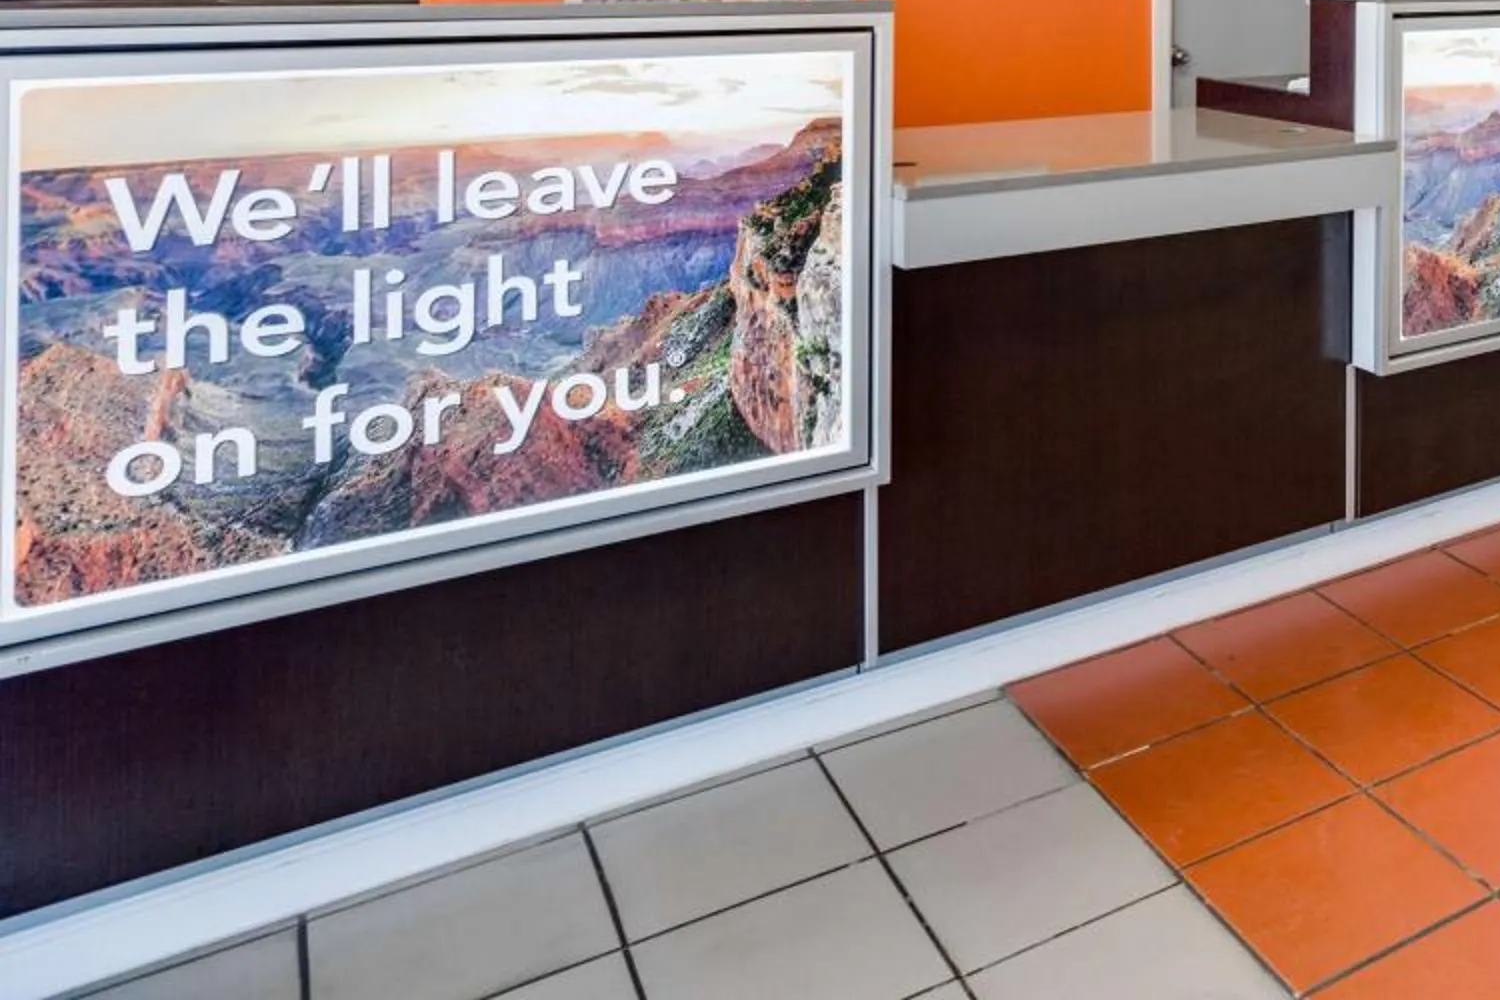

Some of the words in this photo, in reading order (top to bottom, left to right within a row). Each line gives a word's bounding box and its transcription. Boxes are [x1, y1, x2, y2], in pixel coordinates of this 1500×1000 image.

[437, 149, 678, 225] leave
[104, 288, 305, 376] the
[352, 254, 584, 355] light
[105, 426, 257, 497] on
[303, 383, 462, 464] for
